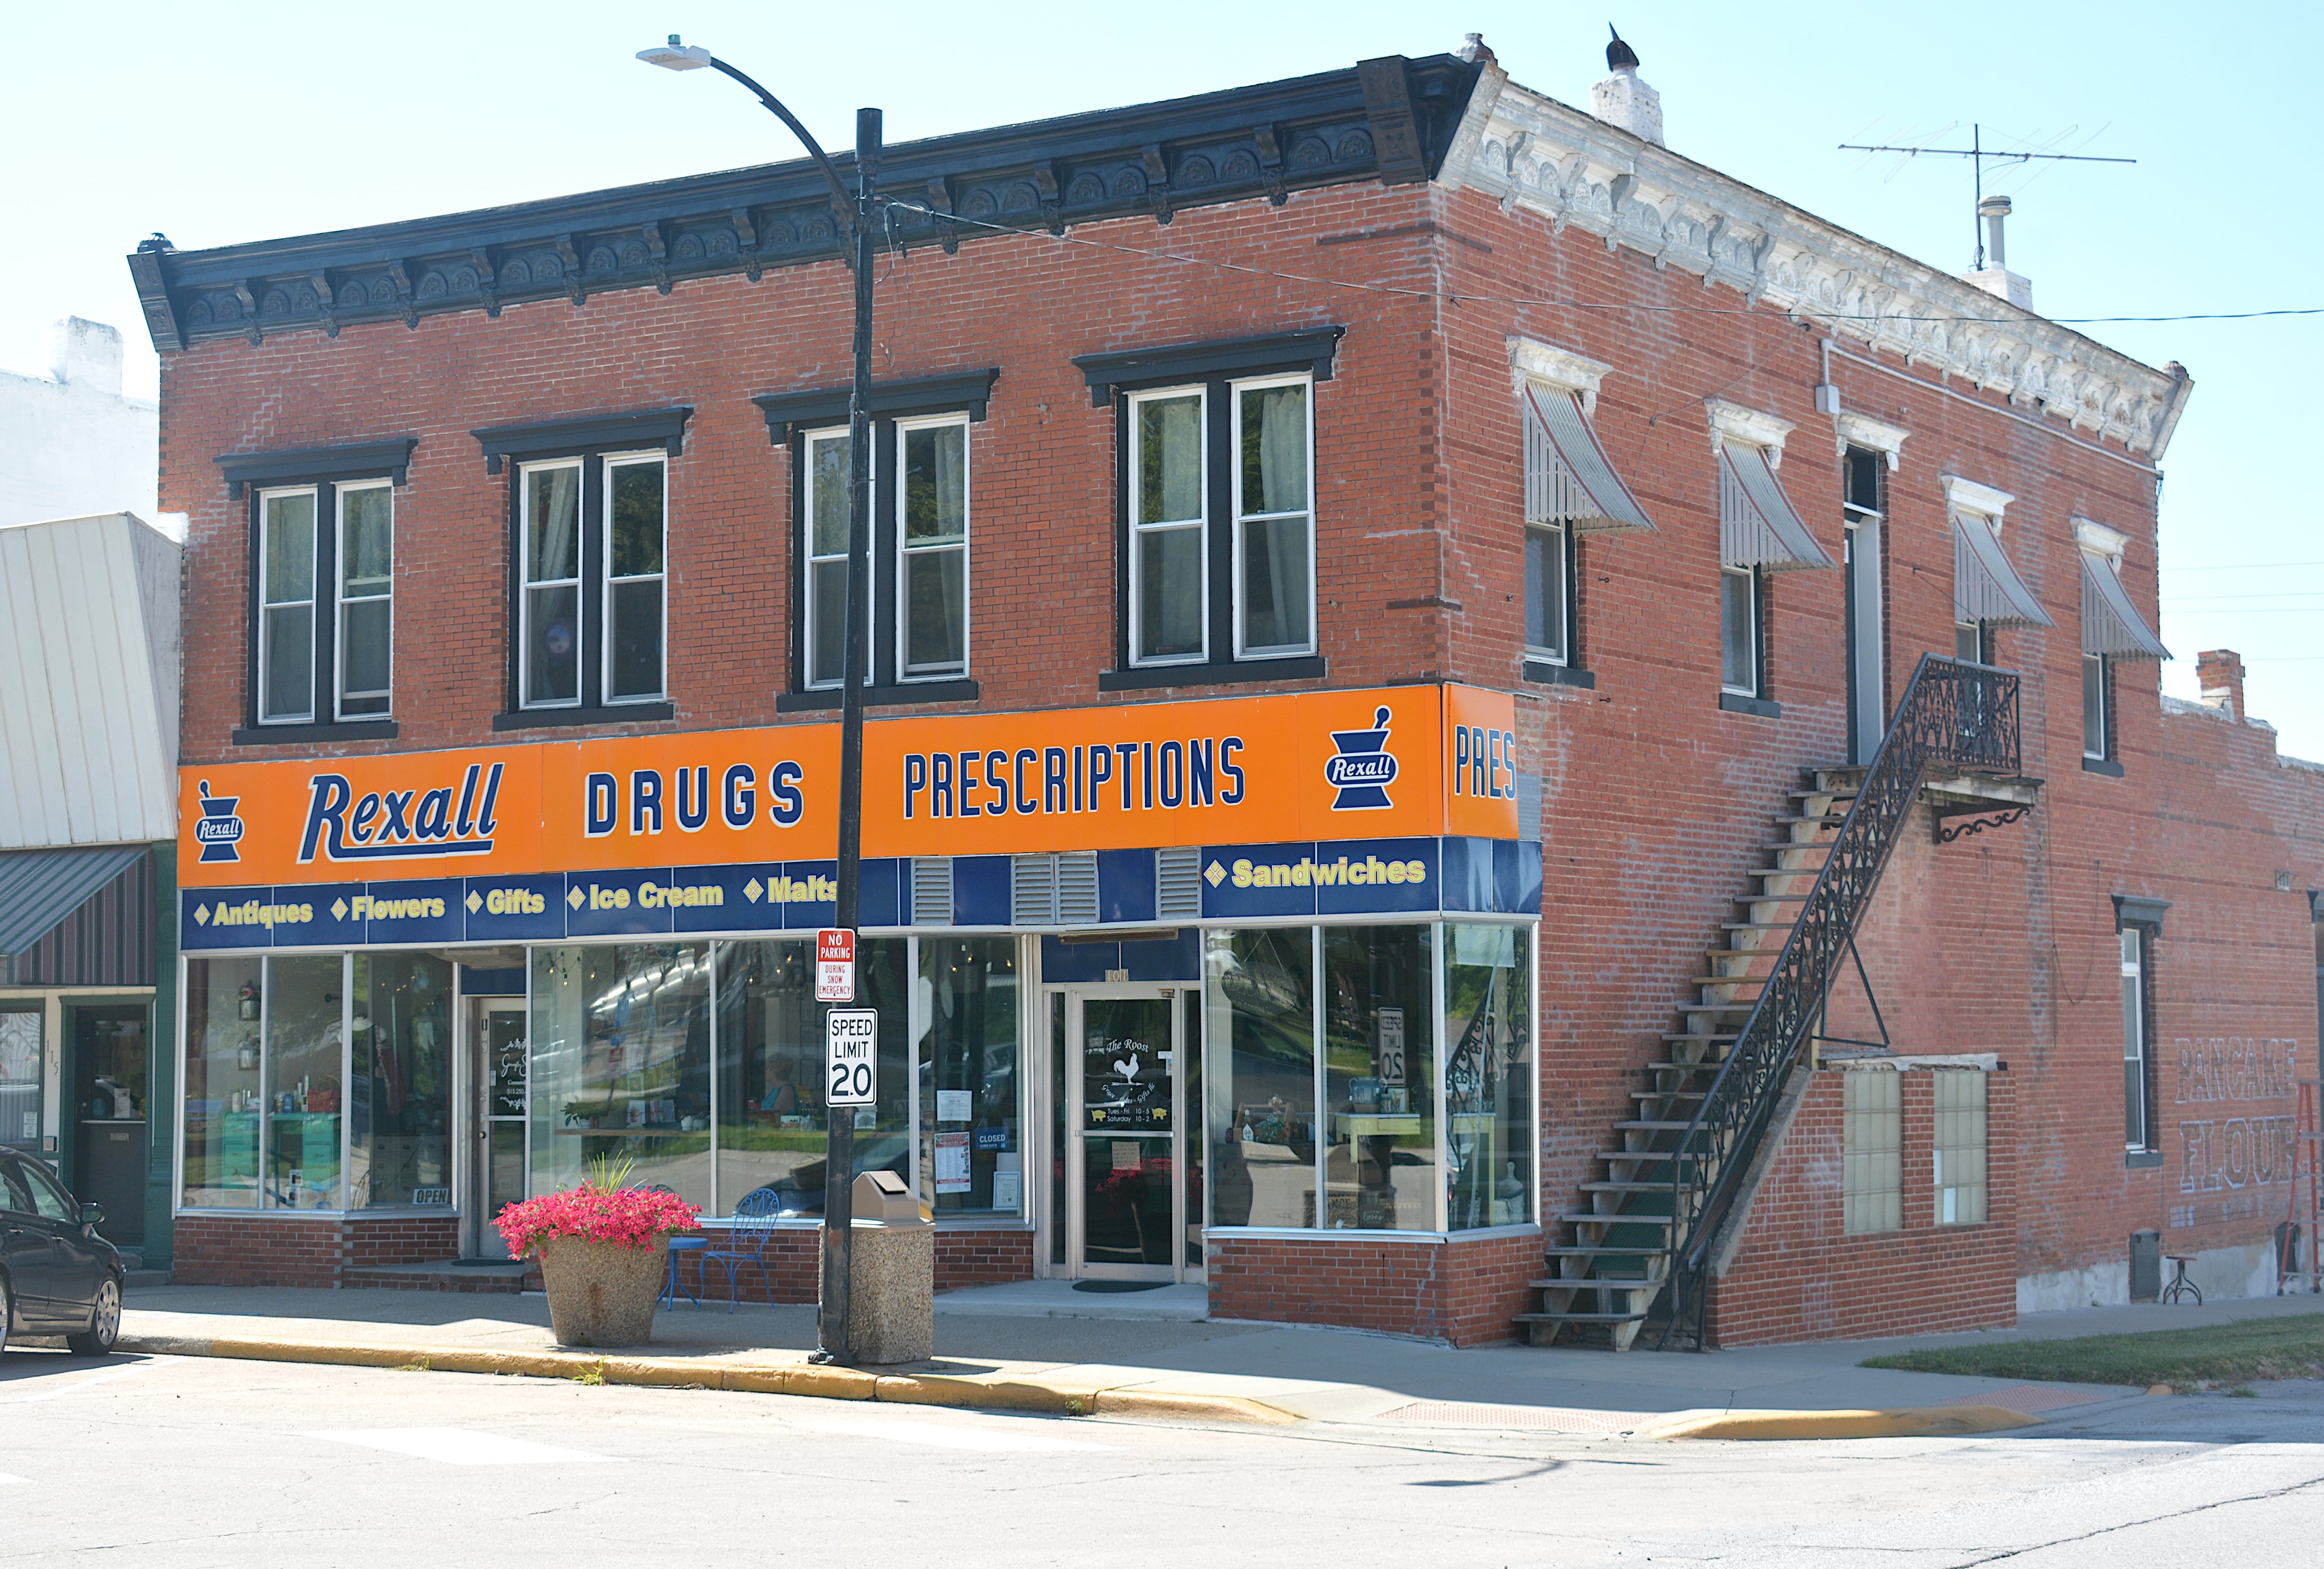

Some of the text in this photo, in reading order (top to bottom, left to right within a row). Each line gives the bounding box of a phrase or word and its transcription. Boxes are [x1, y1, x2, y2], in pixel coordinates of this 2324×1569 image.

[1332, 757, 1390, 781] Rexall
[1454, 725, 1516, 800] PRES
[903, 736, 1245, 820] PRESCRIPTIONS
[584, 760, 804, 838] DRUGS
[296, 762, 505, 864] Rexall
[199, 820, 240, 838] Rexall
[1232, 856, 1426, 888] Sandwiches
[590, 881, 724, 910] Ice Cream
[767, 874, 837, 903] Malts
[351, 895, 445, 921] Flowers
[486, 888, 545, 915] Gifts
[212, 899, 314, 929] Antiques
[828, 934, 842, 946] NO
[821, 947, 850, 959] PARKING
[825, 964, 845, 974] DURING
[828, 975, 843, 984] SNOW
[1108, 969, 1126, 982] 101
[819, 986, 851, 995] EMERGENCY
[832, 1019, 872, 1036] SPEED
[47, 1039, 59, 1075] 115
[835, 1042, 868, 1058] LIMIT
[1106, 1039, 1122, 1052] The
[1124, 1039, 1149, 1052] Roost
[832, 1063, 872, 1096] 20
[2175, 1037, 2298, 1104] PANCAKE
[1102, 1084, 1115, 1098] Grace
[1137, 1090, 1150, 1103] Gifts
[979, 1134, 1005, 1143] CLOSED
[416, 1190, 447, 1203] OPEN
